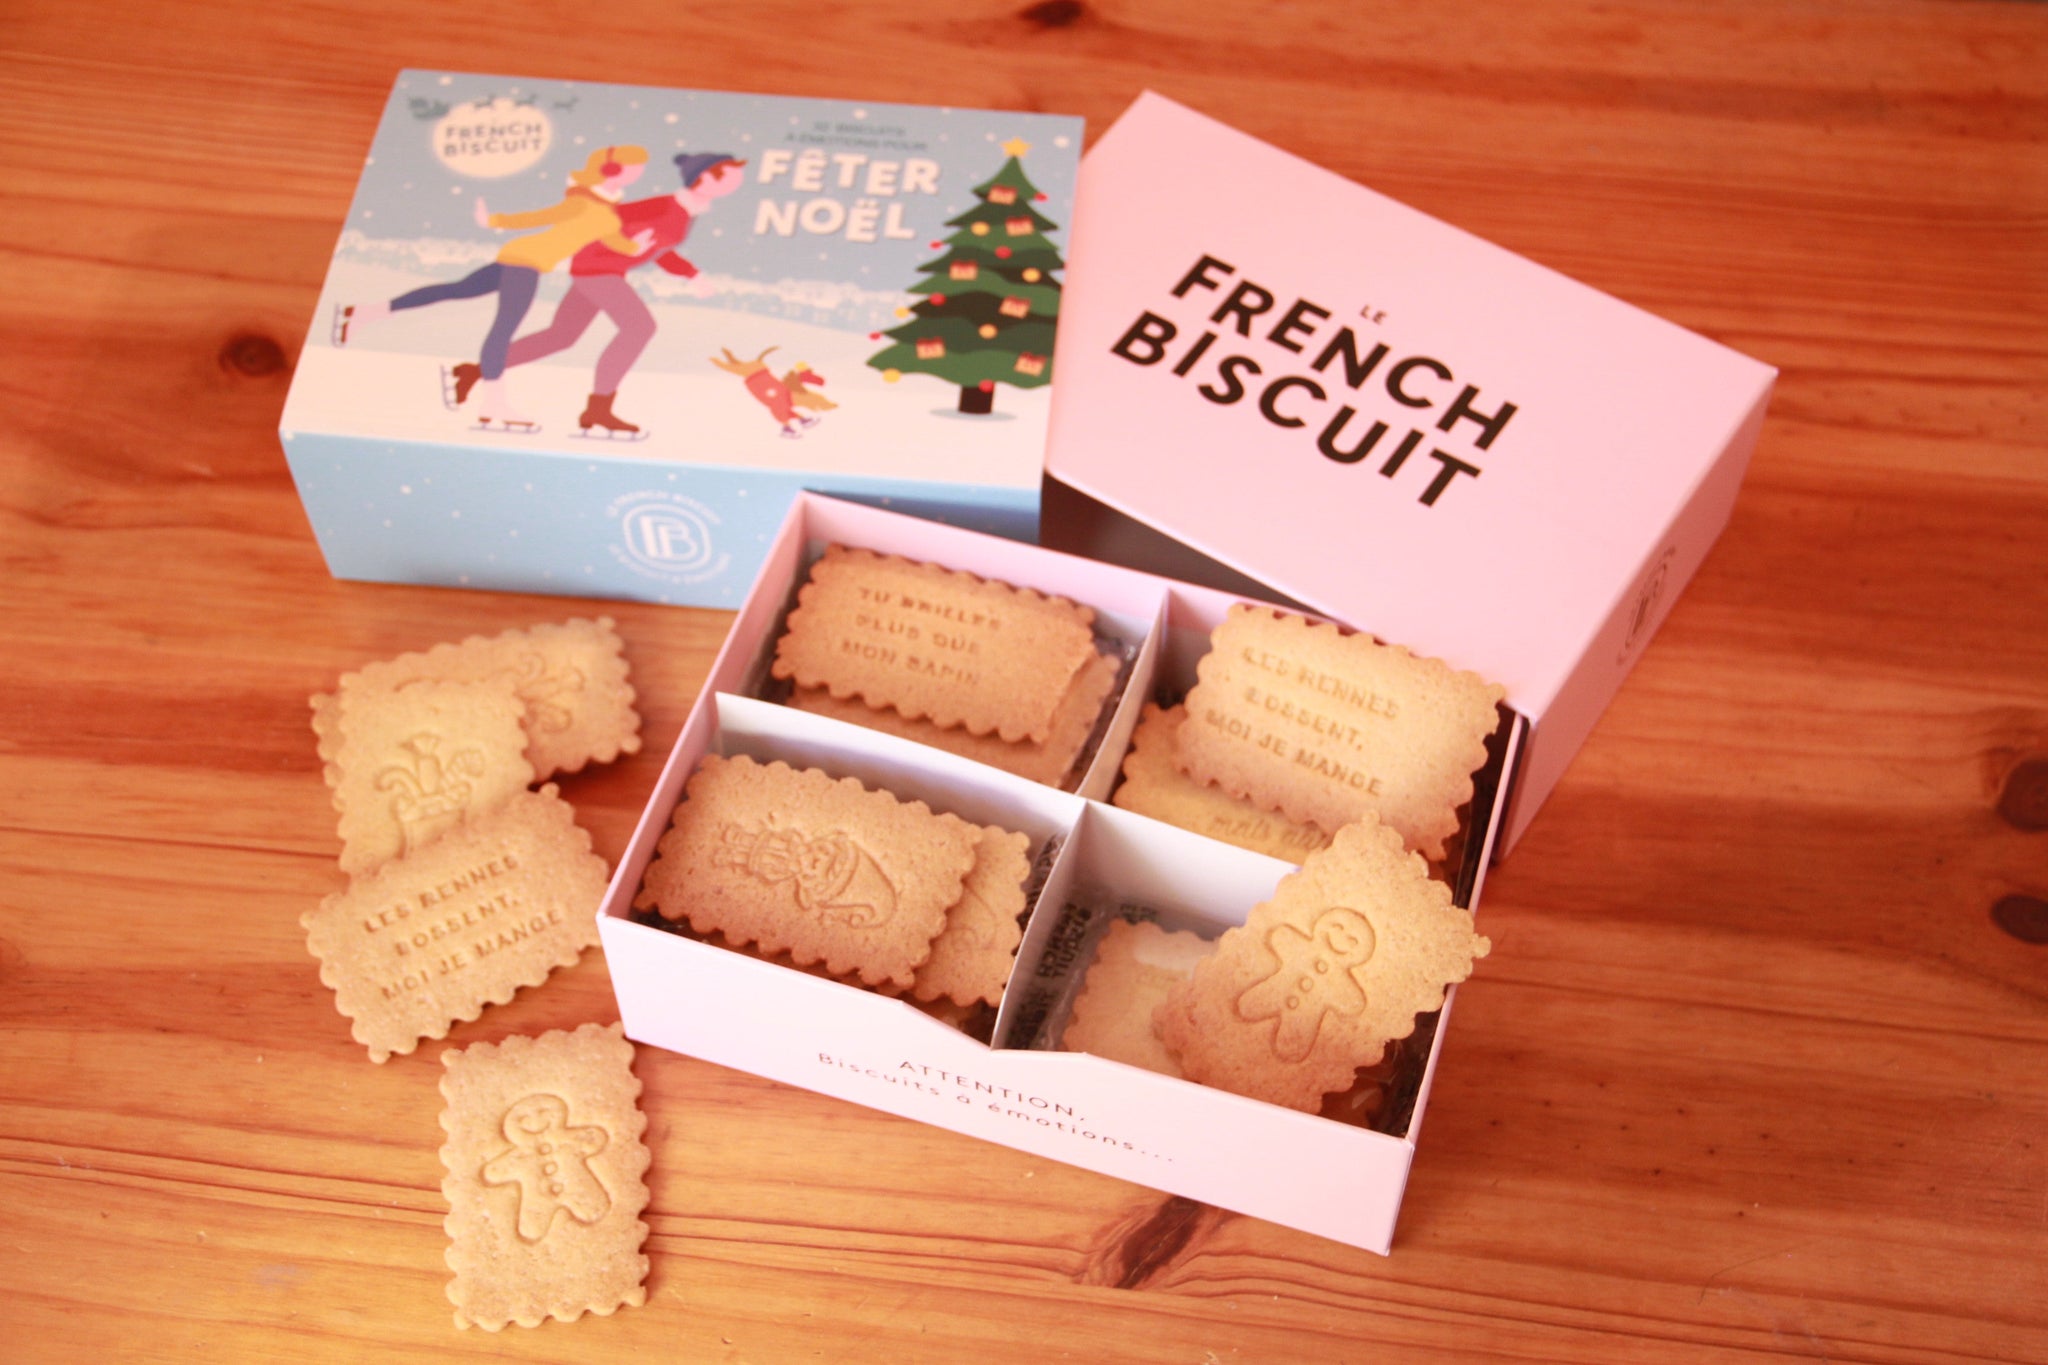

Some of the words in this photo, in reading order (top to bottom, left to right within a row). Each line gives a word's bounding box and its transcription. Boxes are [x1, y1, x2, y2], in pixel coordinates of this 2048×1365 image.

[444, 138, 541, 157] BISCUIT
[446, 121, 542, 139] FRENCH
[757, 148, 941, 197] FÊTER
[754, 197, 917, 243] NOËL
[1359, 305, 1388, 326] LE
[1170, 254, 1519, 451] FRENCH
[1110, 310, 1481, 508] BISCUIT
[856, 614, 920, 640] PLUS
[933, 632, 980, 654] QUE
[1243, 647, 1289, 677] LES
[1298, 665, 1400, 720] RENNES
[1205, 708, 1252, 741] MOI
[1258, 733, 1289, 758] JE
[1294, 749, 1385, 798] MANGE
[363, 904, 411, 934] LES
[381, 969, 430, 1001] MOI
[439, 952, 467, 976] JE
[474, 907, 563, 958] MANGE
[818, 1052, 940, 1097] Biscuits
[956, 1092, 971, 1105] à
[899, 1060, 1086, 1122] ATTENTION,
